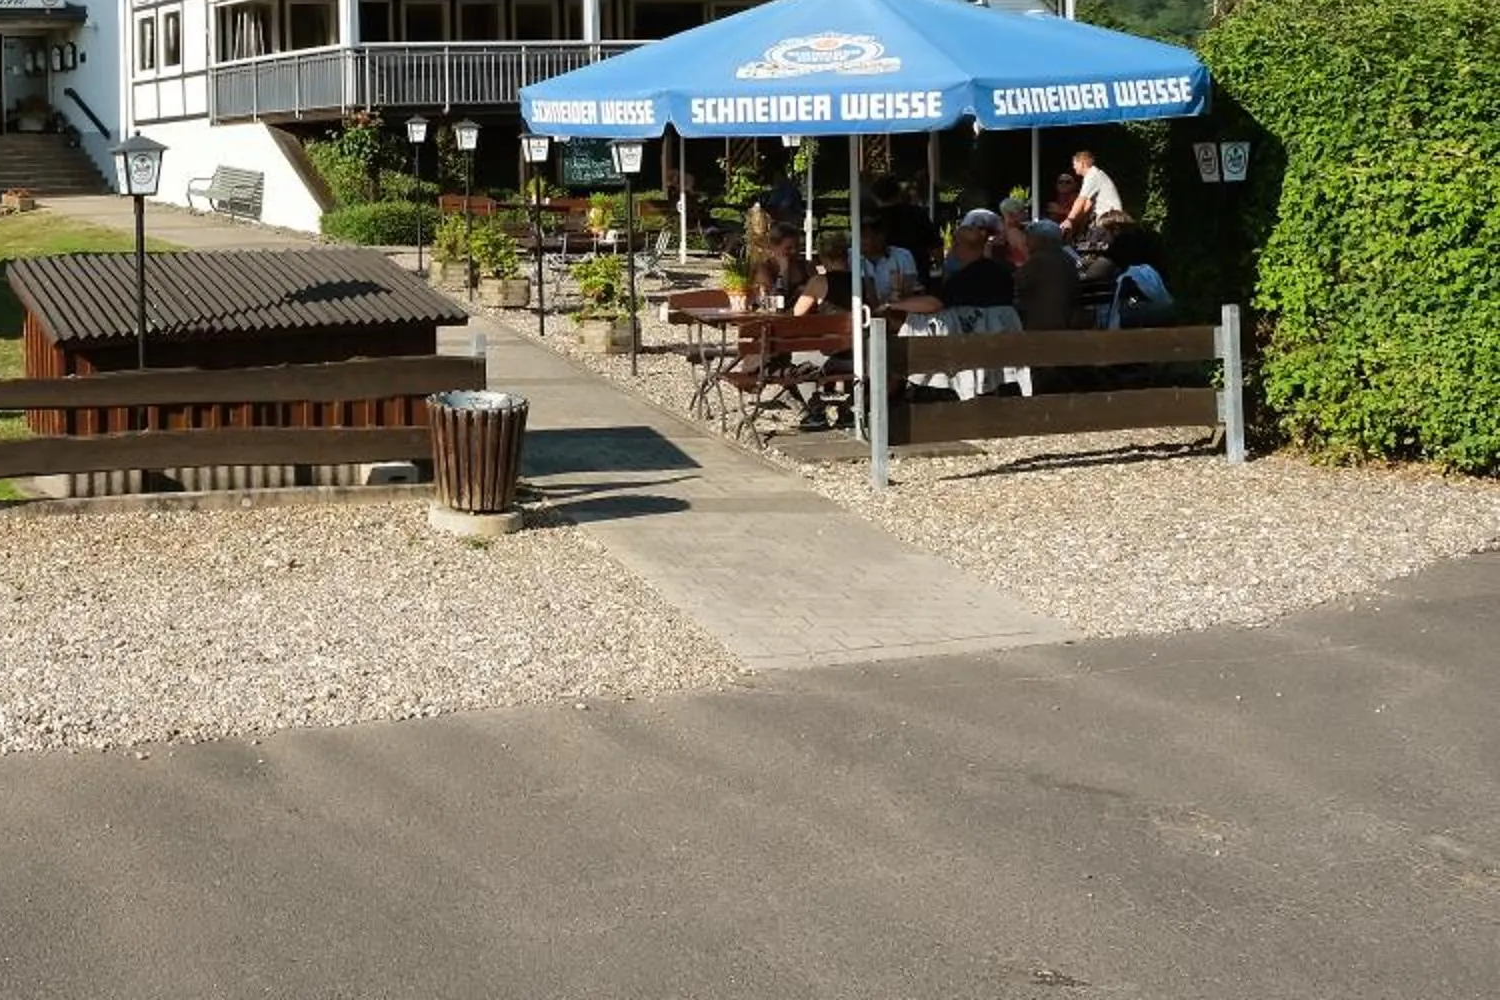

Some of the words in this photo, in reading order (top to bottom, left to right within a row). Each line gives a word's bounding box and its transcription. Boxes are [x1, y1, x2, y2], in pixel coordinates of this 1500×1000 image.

[531, 99, 597, 124] SCHNEIDER
[601, 99, 655, 125] WEISSE
[691, 94, 831, 124] SCHNEIDER
[840, 91, 943, 121] WEISSE
[993, 83, 1108, 116] SCHNEIDER
[1113, 76, 1192, 107] WEISSE
